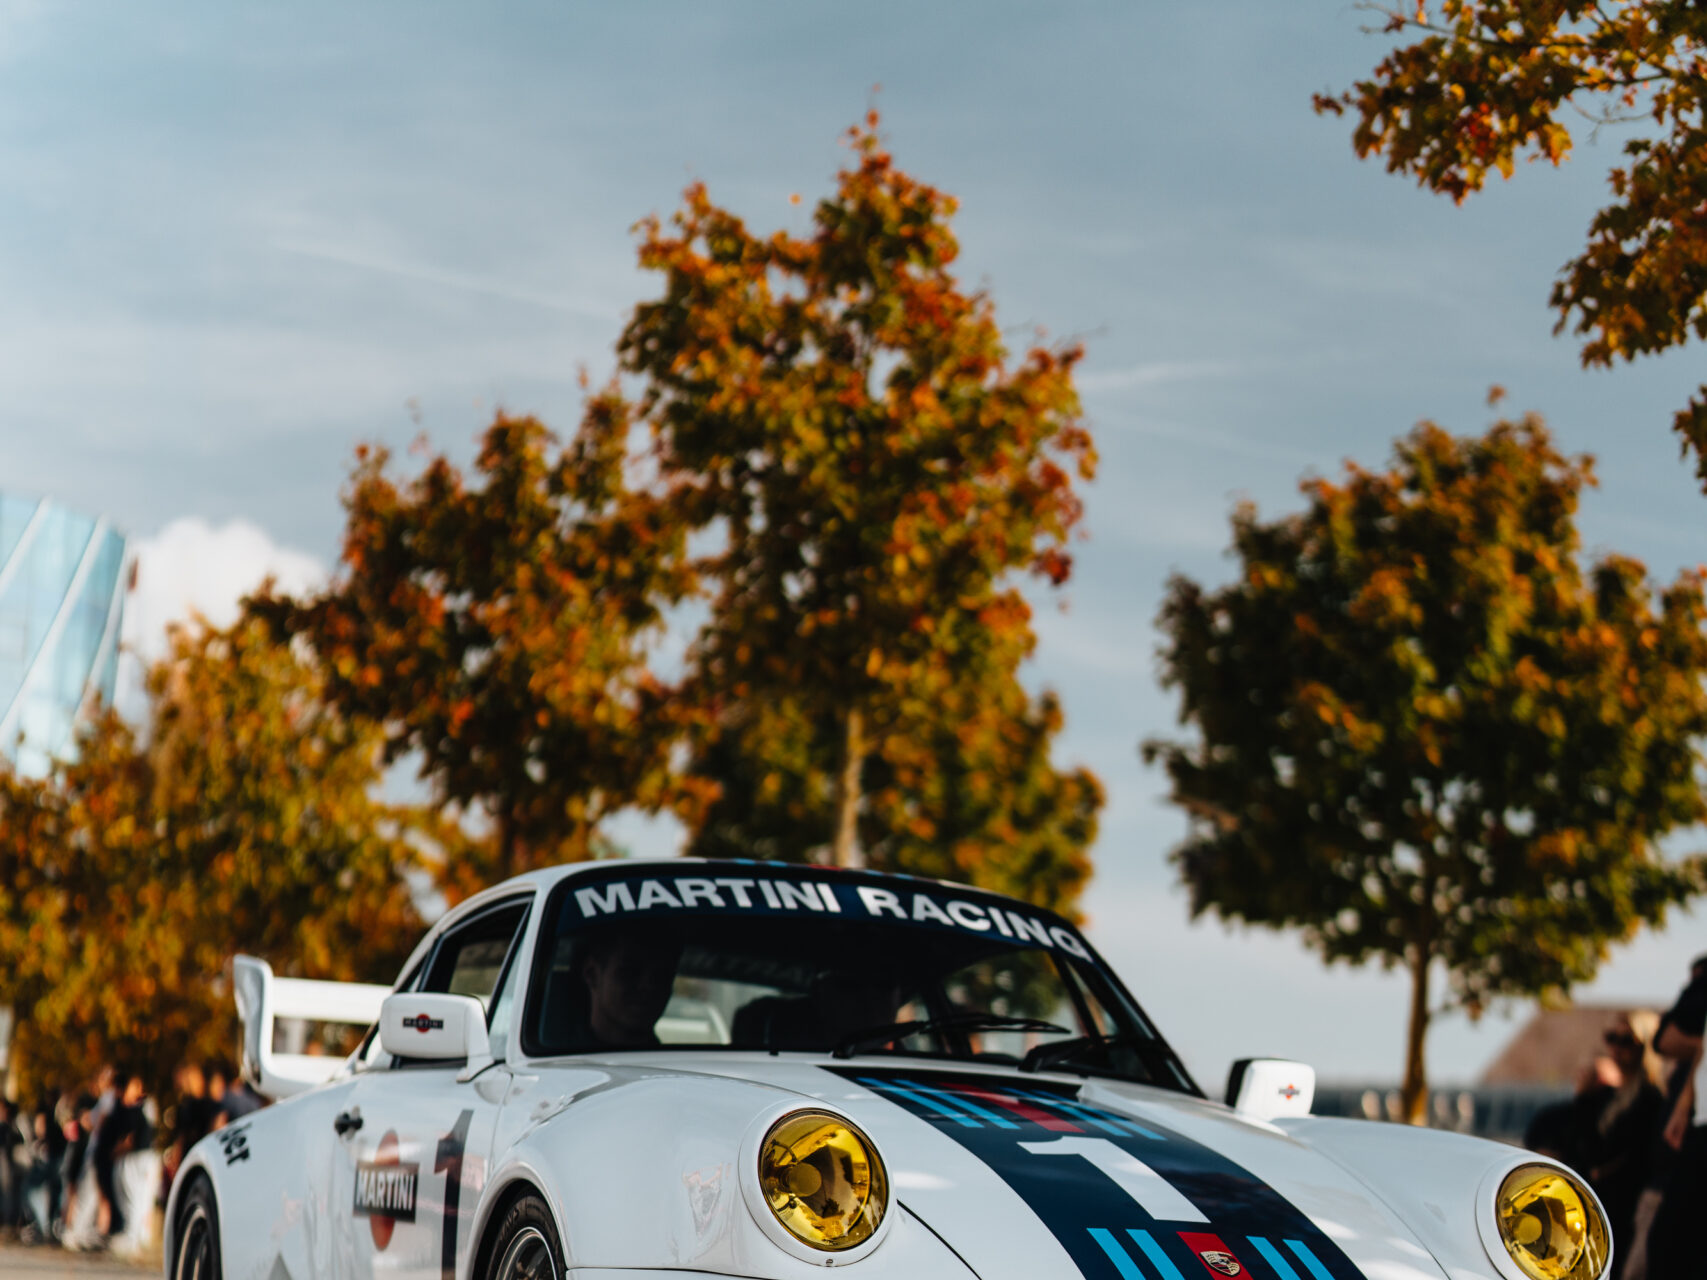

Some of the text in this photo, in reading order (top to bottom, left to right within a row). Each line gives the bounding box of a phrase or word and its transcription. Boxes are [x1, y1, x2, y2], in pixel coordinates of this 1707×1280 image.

[574, 877, 1094, 963] MARTINI RACING
[356, 1167, 414, 1211] MARTINI
[1016, 1135, 1212, 1224] 1
